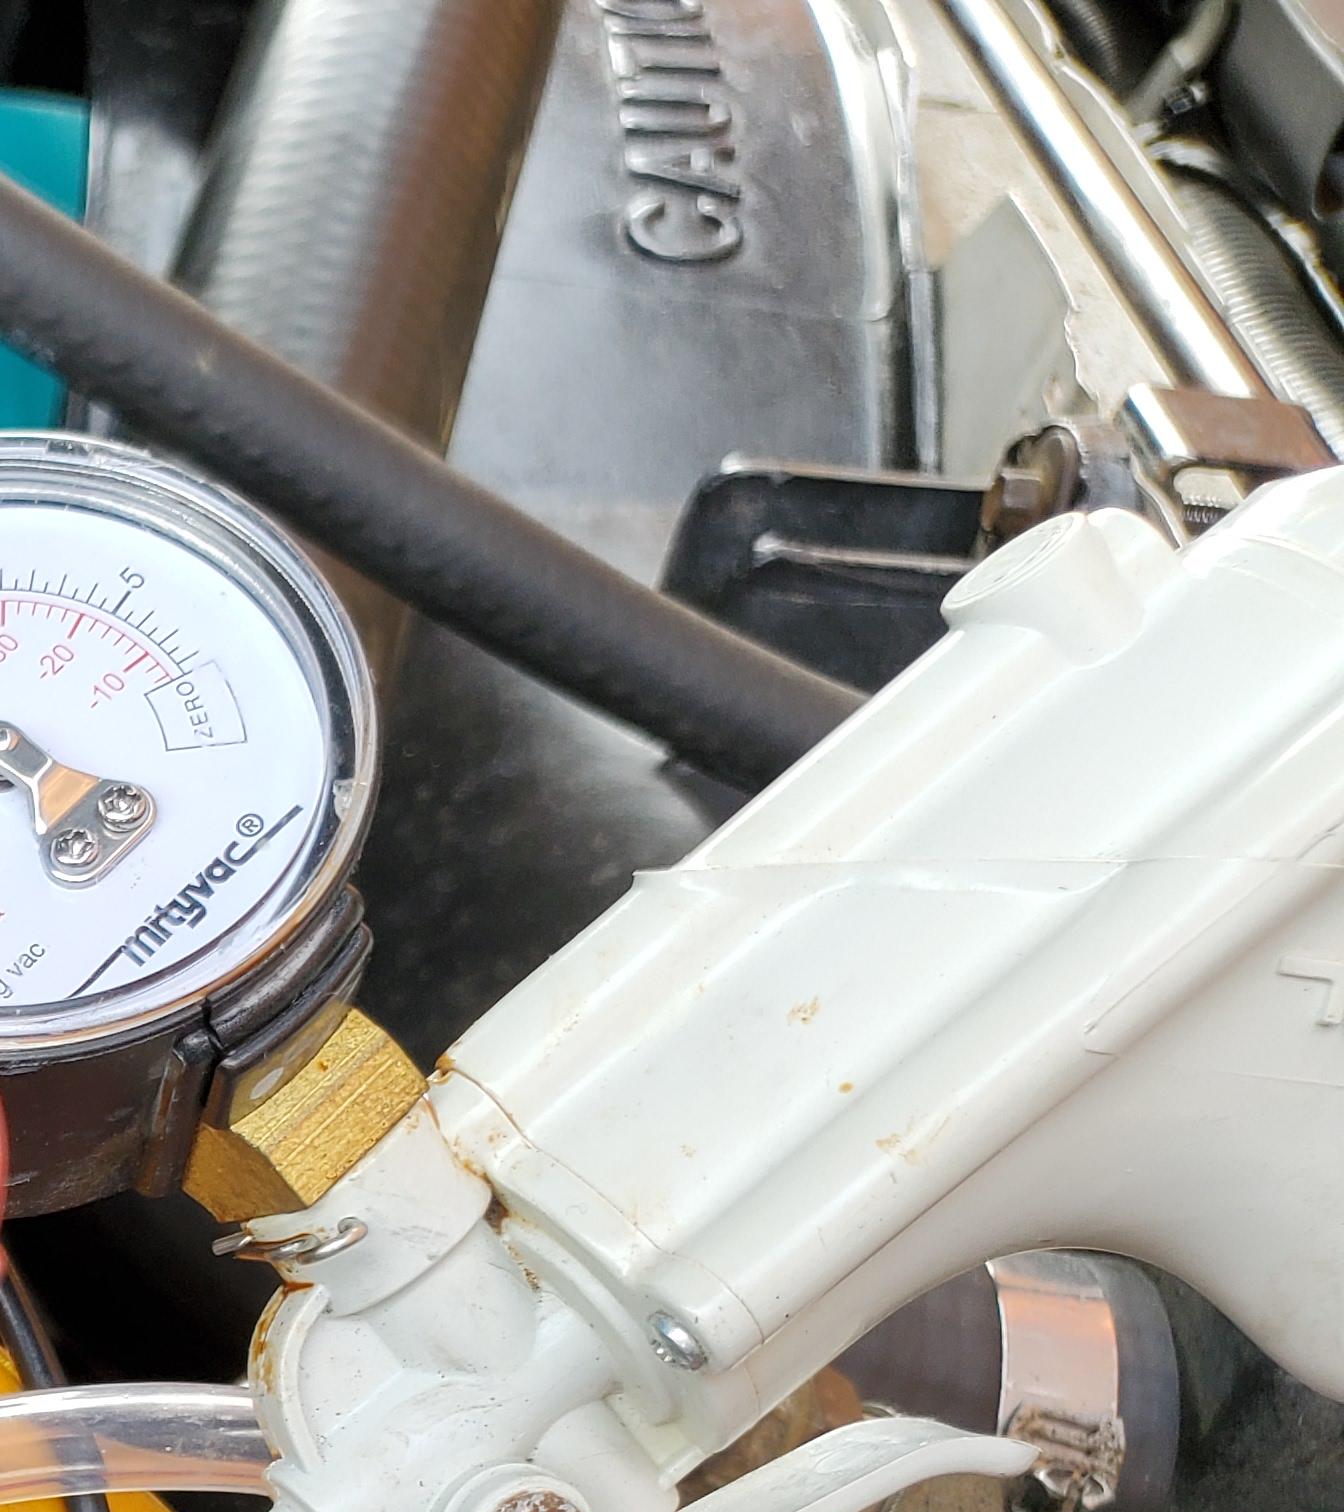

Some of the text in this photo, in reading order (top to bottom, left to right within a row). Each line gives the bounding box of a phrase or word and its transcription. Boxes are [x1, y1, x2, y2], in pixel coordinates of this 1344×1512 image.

[119, 566, 145, 590] 5
[40, 645, 75, 679] -20
[90, 673, 125, 709] -10
[176, 681, 214, 738] ZERO
[6, 942, 46, 978] vac
